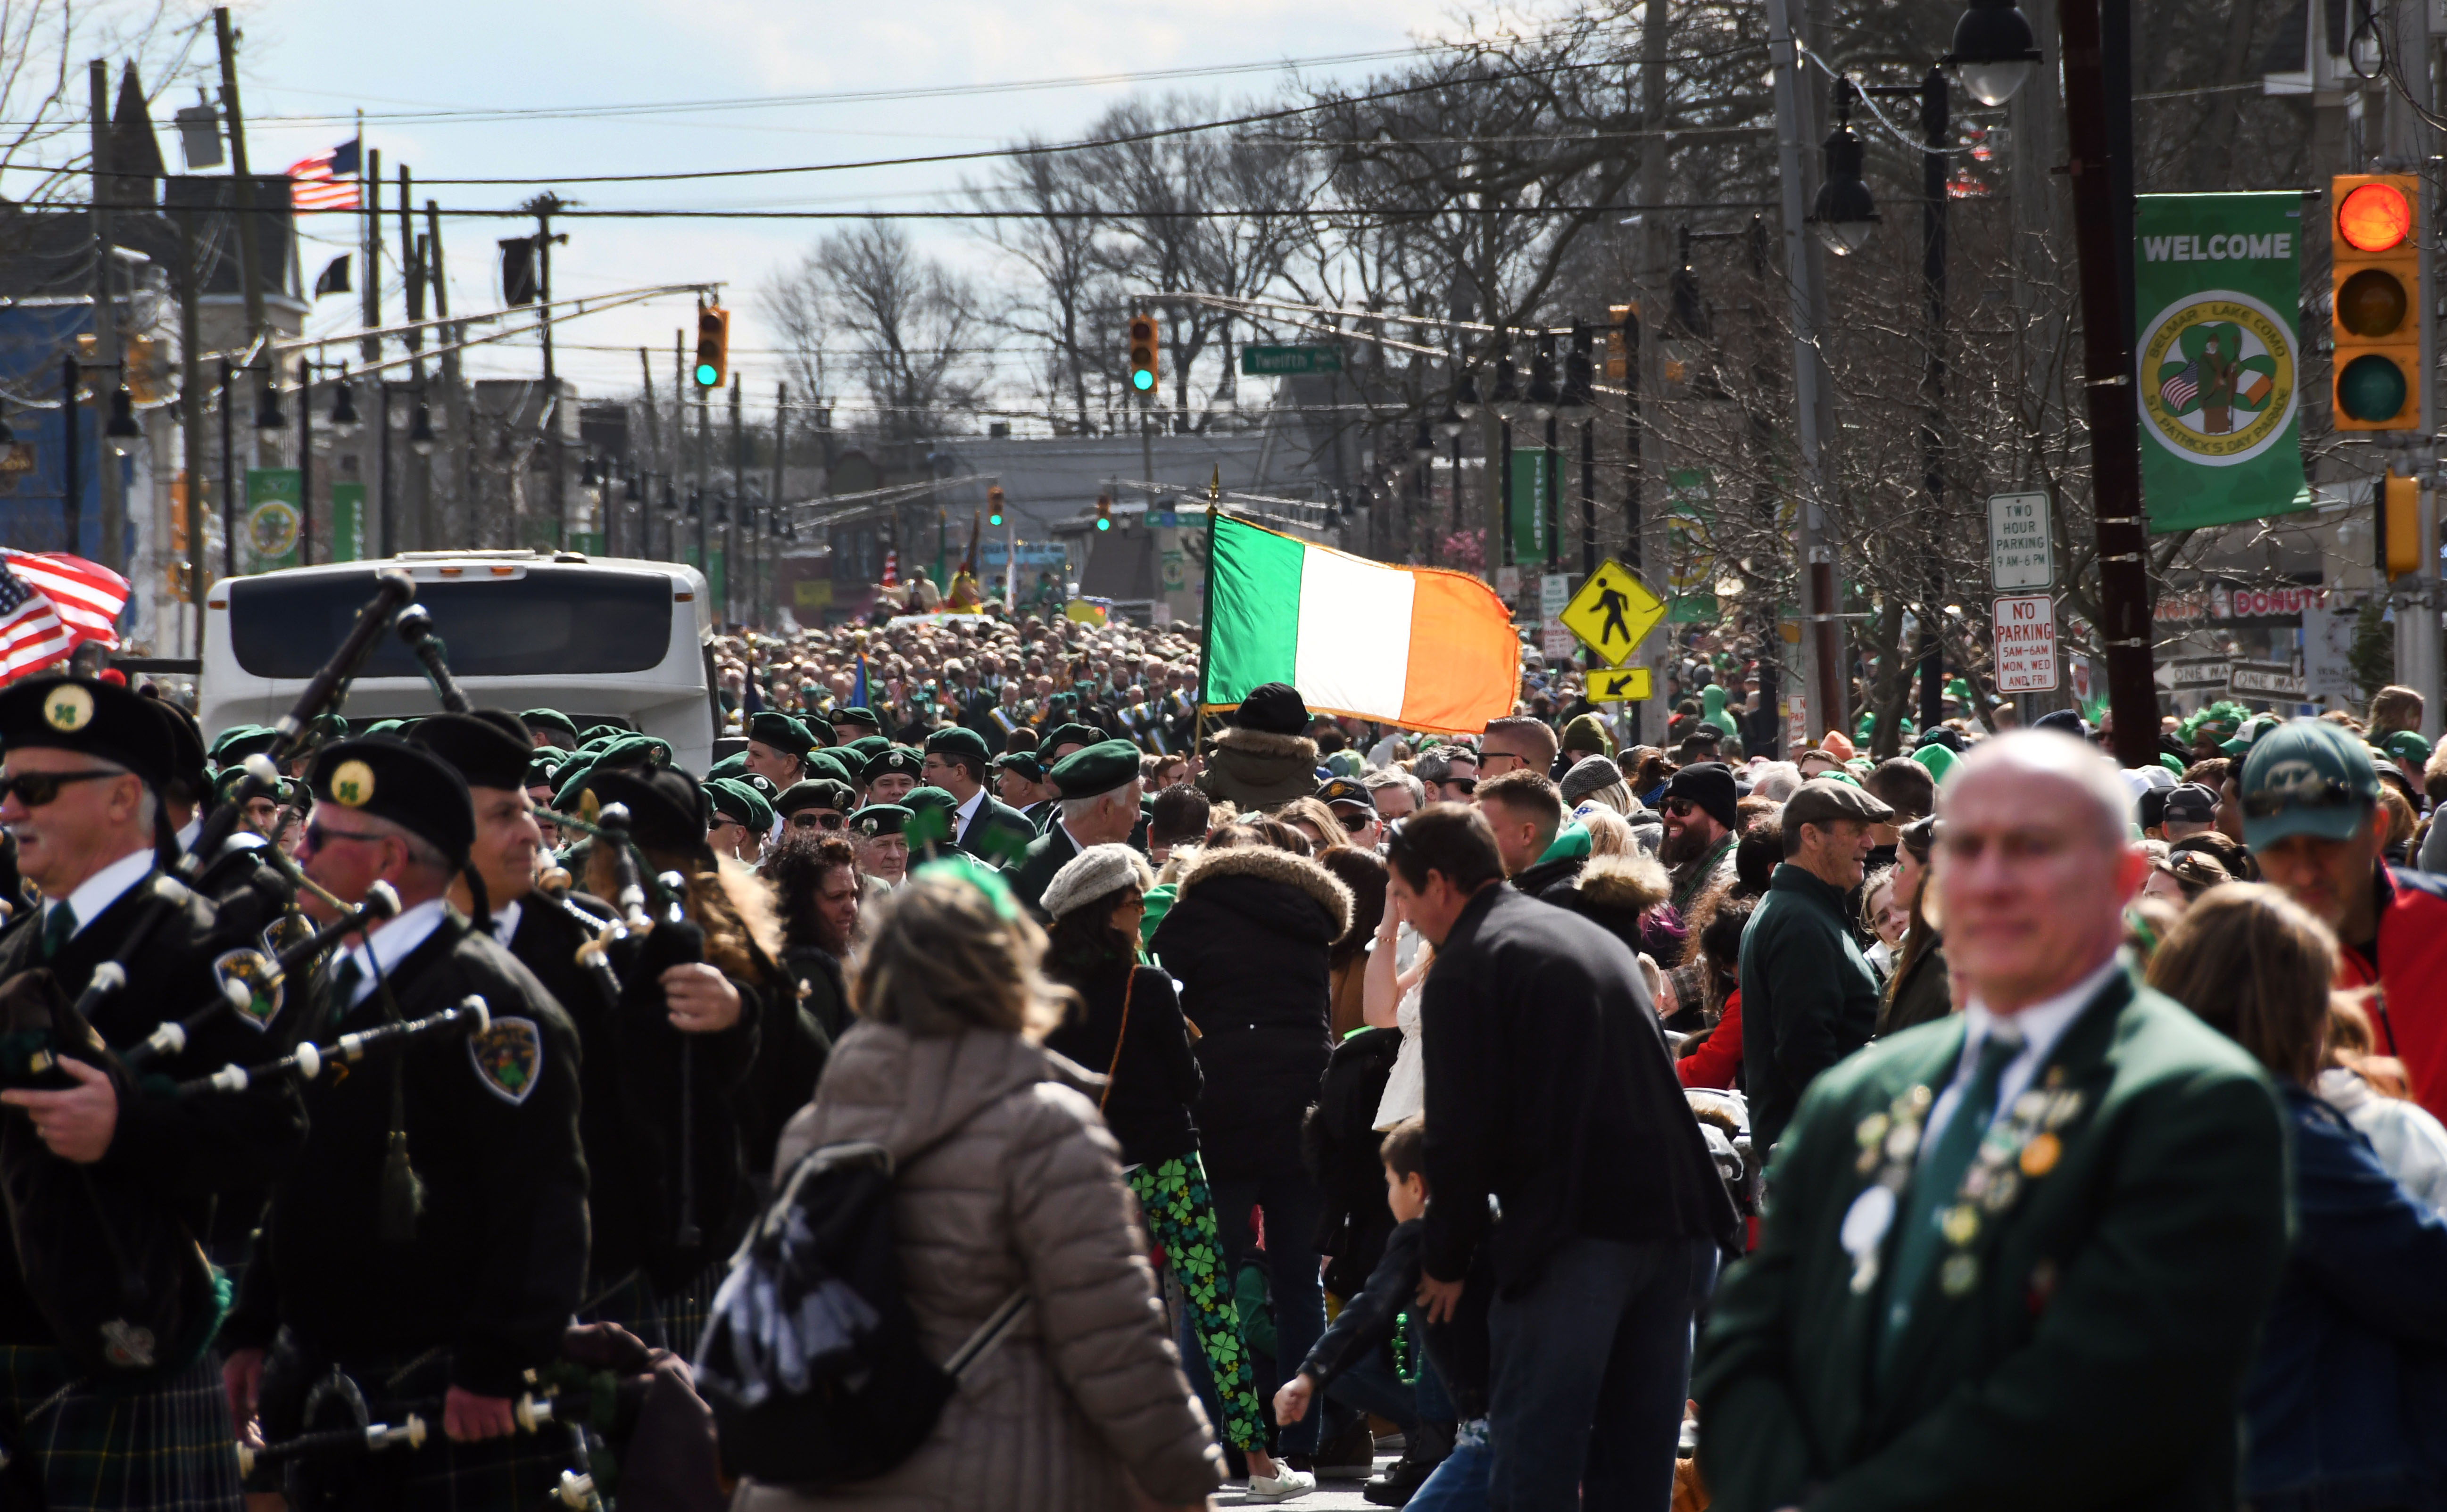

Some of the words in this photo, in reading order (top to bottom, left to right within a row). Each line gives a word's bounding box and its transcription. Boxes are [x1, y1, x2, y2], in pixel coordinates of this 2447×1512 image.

[2143, 233, 2292, 262] WELCOME
[2149, 309, 2198, 359] BELMAR
[2212, 306, 2251, 321] LAKE
[2254, 318, 2286, 358] COMO
[1255, 352, 1308, 370] Twelfth
[2160, 417, 2223, 453] PATRICK'S
[2226, 433, 2252, 449] DAY
[2252, 388, 2288, 436] PARADE
[2005, 504, 2032, 518] TWO
[2003, 521, 2036, 535] HOUR
[1996, 536, 2045, 551] PARKING
[1997, 556, 2003, 568] 9
[2033, 554, 2045, 566] PM
[2012, 602, 2035, 620] NO
[1998, 622, 2052, 643] PARKING
[2003, 645, 2049, 658] 5AM-6AM
[2002, 661, 2027, 673] MON,
[2031, 659, 2050, 670] WED
[2174, 667, 2202, 681] ONE
[2210, 664, 2230, 679] WA
[2008, 676, 2027, 686] AND
[2032, 674, 2047, 685] FRI
[2239, 671, 2267, 688] ONE
[2274, 675, 2306, 692] WAY
